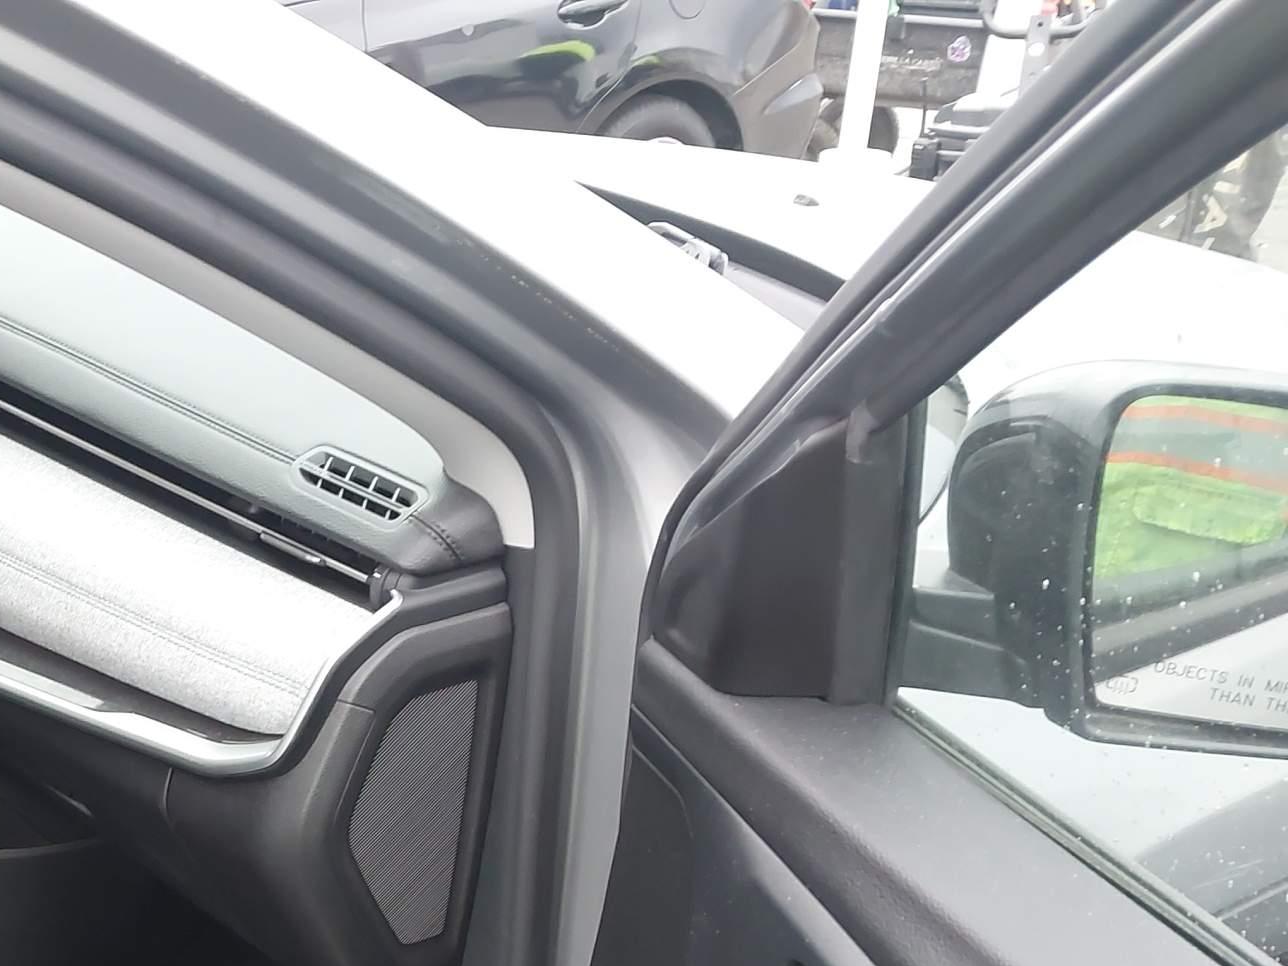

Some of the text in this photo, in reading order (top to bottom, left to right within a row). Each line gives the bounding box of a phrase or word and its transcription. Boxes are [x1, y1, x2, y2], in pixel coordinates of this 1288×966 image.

[1154, 660, 1228, 684] OBJECTS
[1237, 673, 1255, 689] IN
[1209, 686, 1256, 706] THAN
